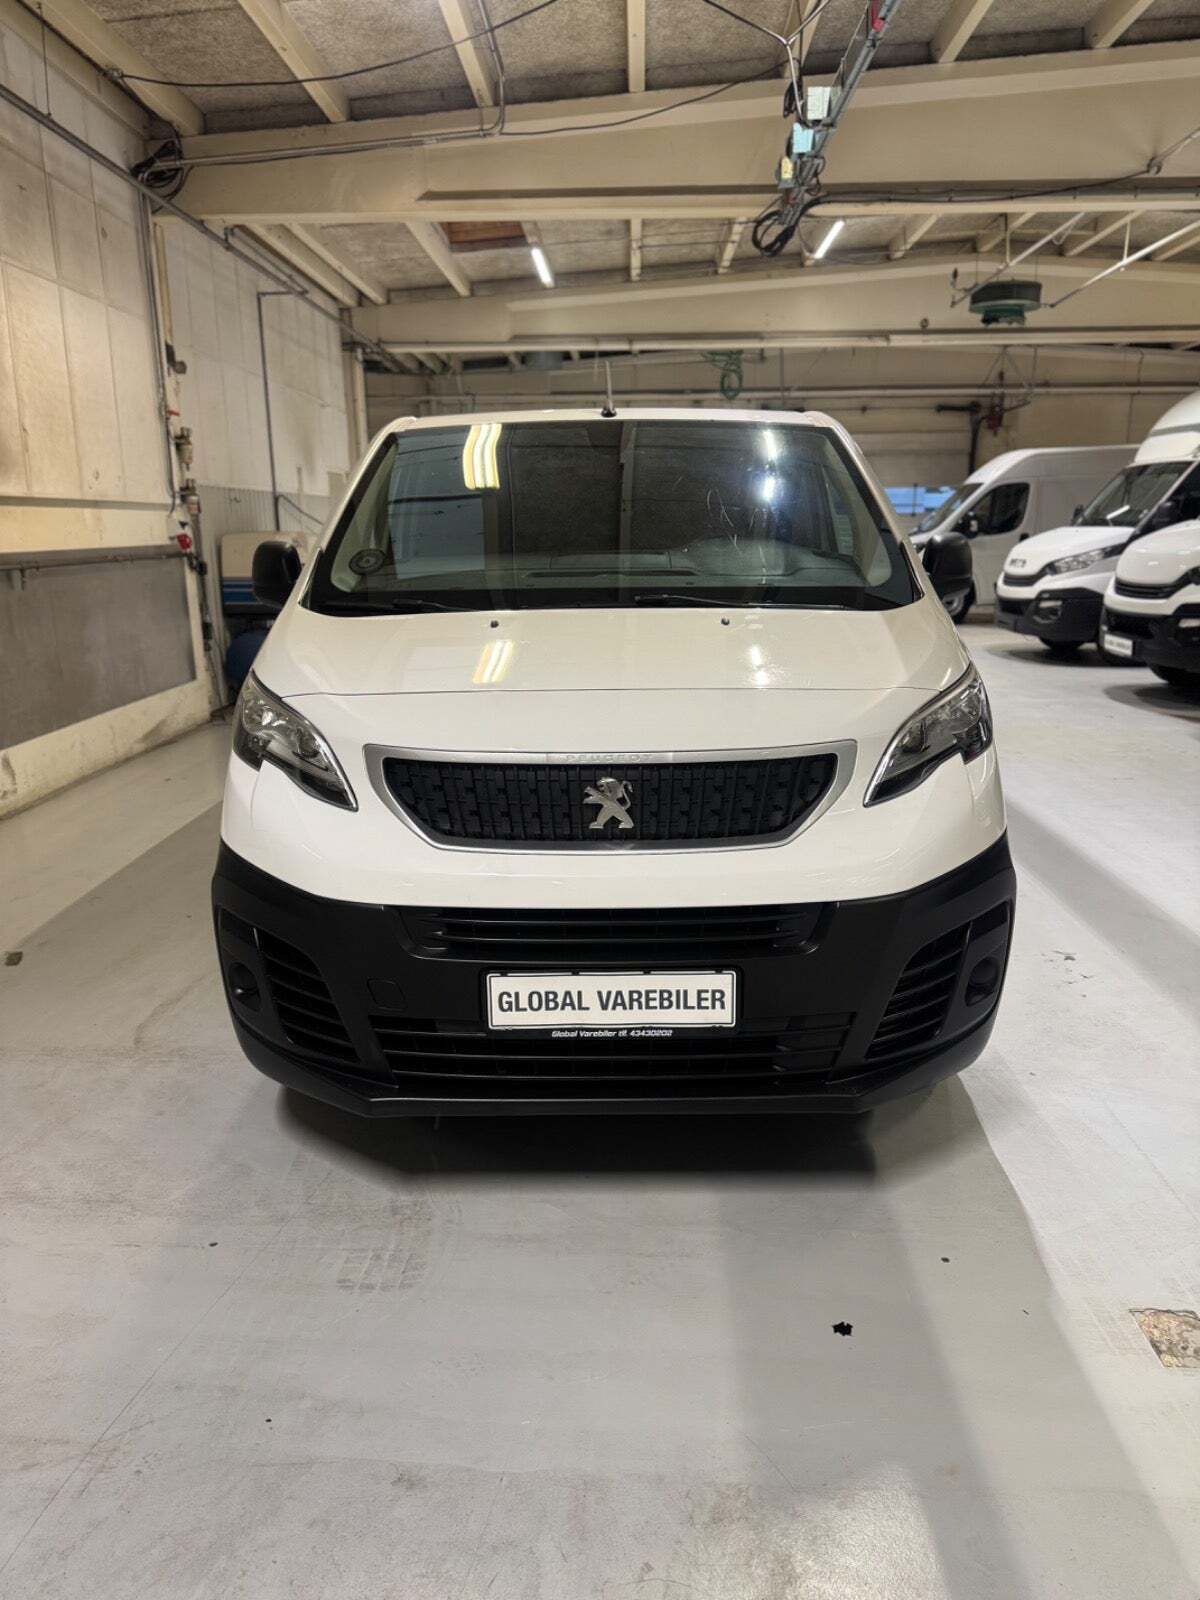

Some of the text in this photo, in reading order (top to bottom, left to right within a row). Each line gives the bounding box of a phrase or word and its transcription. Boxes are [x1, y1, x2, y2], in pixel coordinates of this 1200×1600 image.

[565, 754, 653, 763] PEUGEOT
[497, 989, 727, 1012] GLOBAL VAREBILER
[551, 1030, 578, 1038] Global
[579, 1030, 617, 1038] Varebiler
